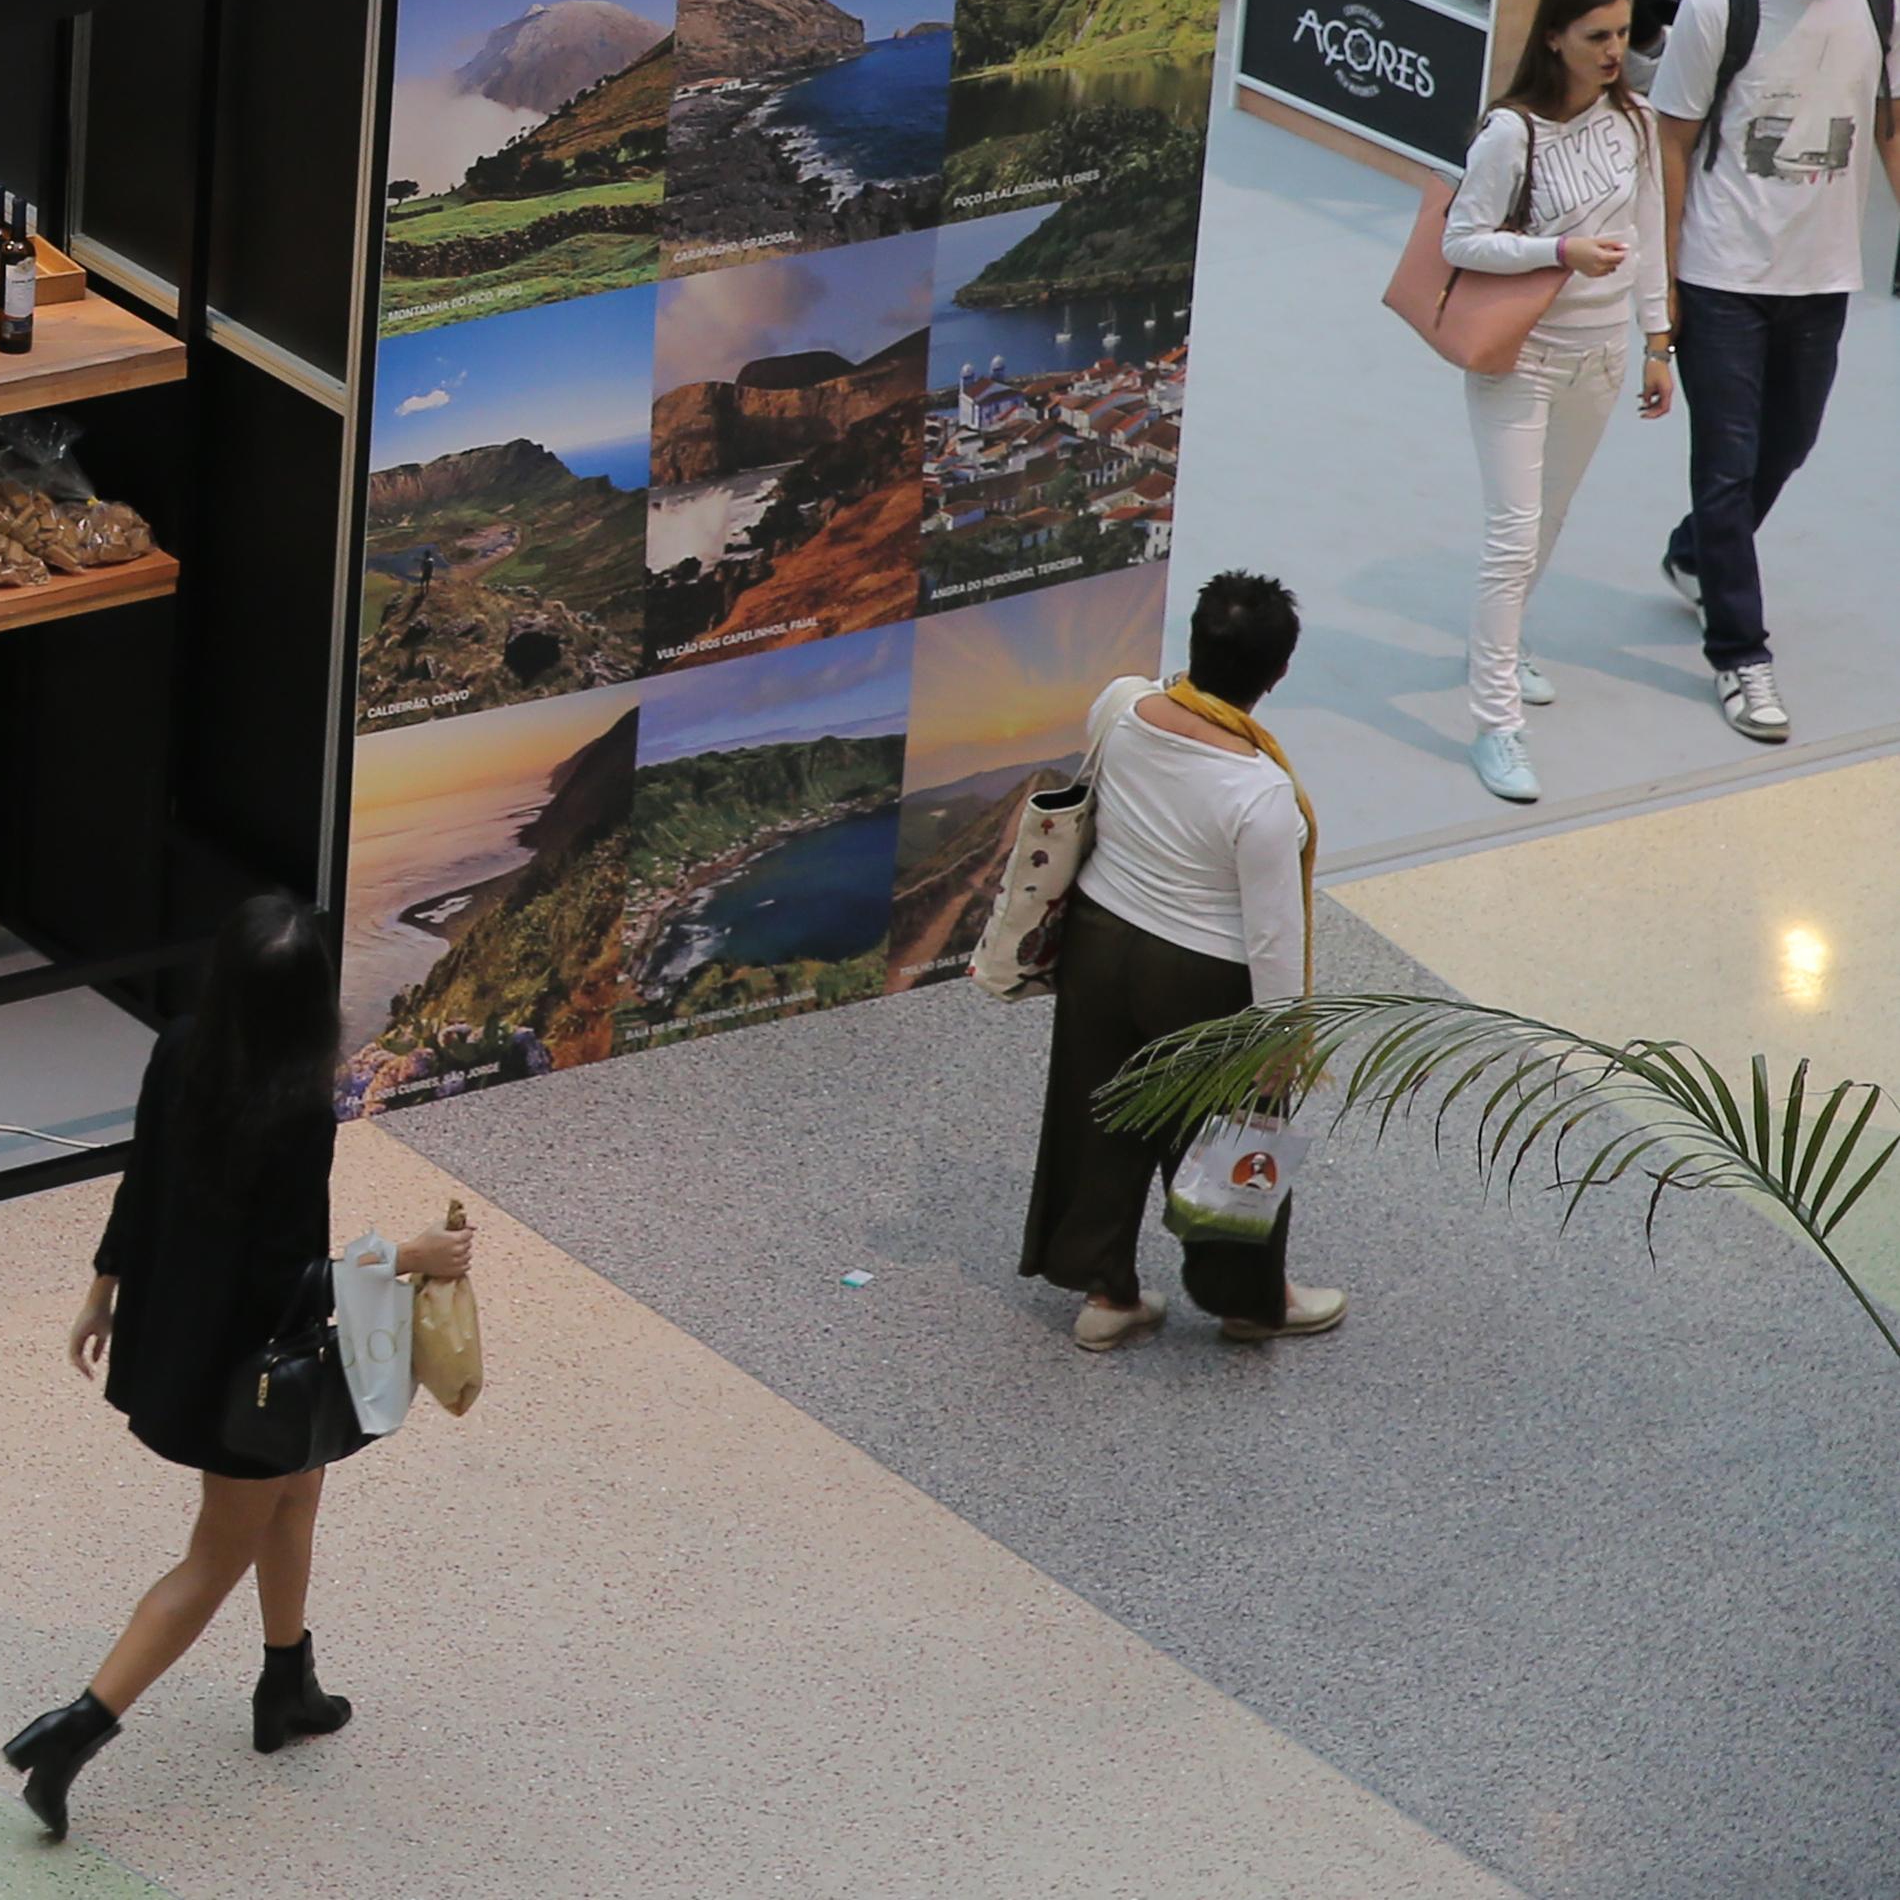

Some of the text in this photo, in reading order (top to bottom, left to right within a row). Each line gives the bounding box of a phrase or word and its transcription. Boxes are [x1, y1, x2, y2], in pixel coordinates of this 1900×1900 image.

[1293, 8, 1435, 98] AÇORES
[953, 191, 982, 208] POÇO
[984, 187, 998, 199] DA
[1063, 168, 1101, 186] FLORES
[740, 230, 796, 251] GRACIOSA
[931, 582, 966, 600] ANGRA
[967, 578, 982, 591] DO
[1038, 555, 1084, 575] TERCEIRA
[656, 639, 699, 660] VULCÃO
[699, 635, 720, 650] DOS
[790, 616, 819, 631] FAIAL
[367, 689, 470, 719] CALDEIRÃO, CORVO
